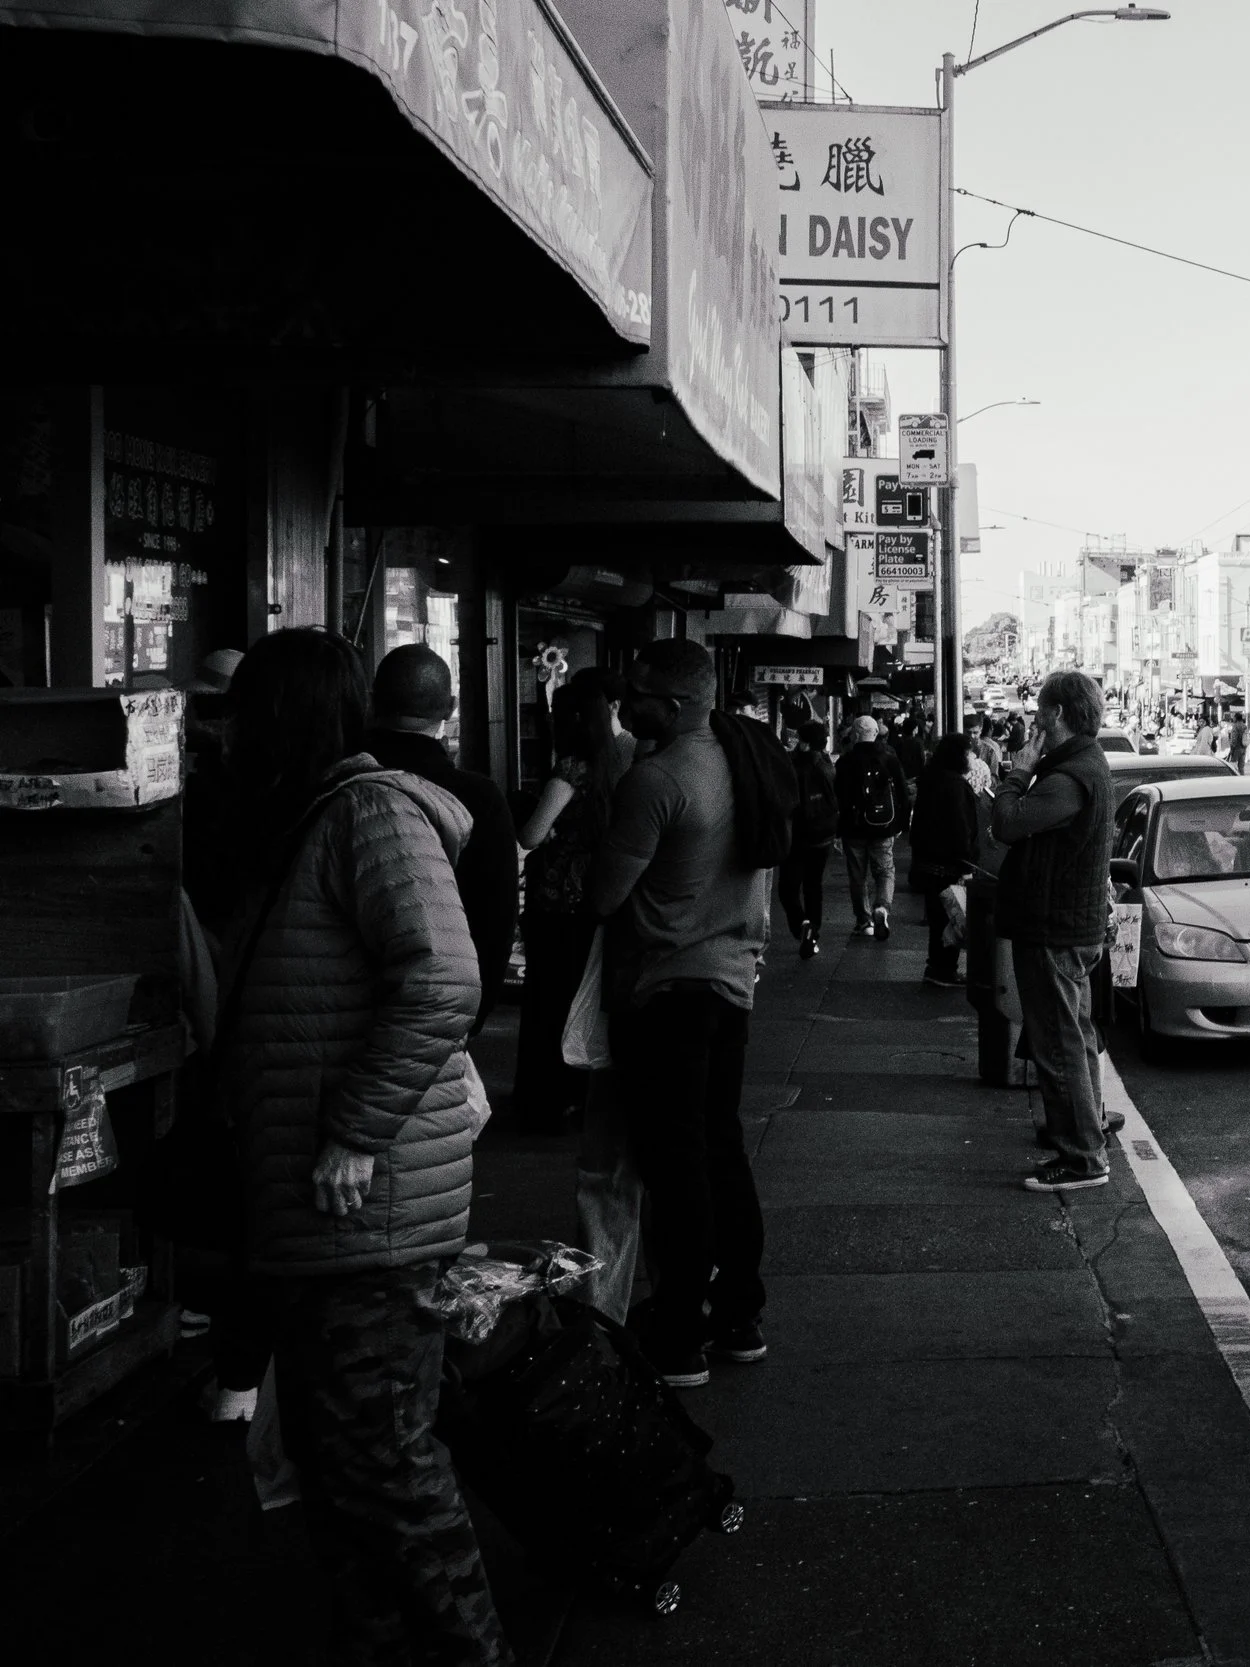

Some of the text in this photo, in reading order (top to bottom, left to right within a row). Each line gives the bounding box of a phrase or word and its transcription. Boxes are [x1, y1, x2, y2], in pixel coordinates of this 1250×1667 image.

[809, 214, 914, 260] DAISY
[879, 480, 898, 492] Pay
[879, 534, 913, 546] Pay by
[879, 545, 916, 554] License
[879, 554, 904, 563] Plate
[881, 567, 923, 575] 66410003
